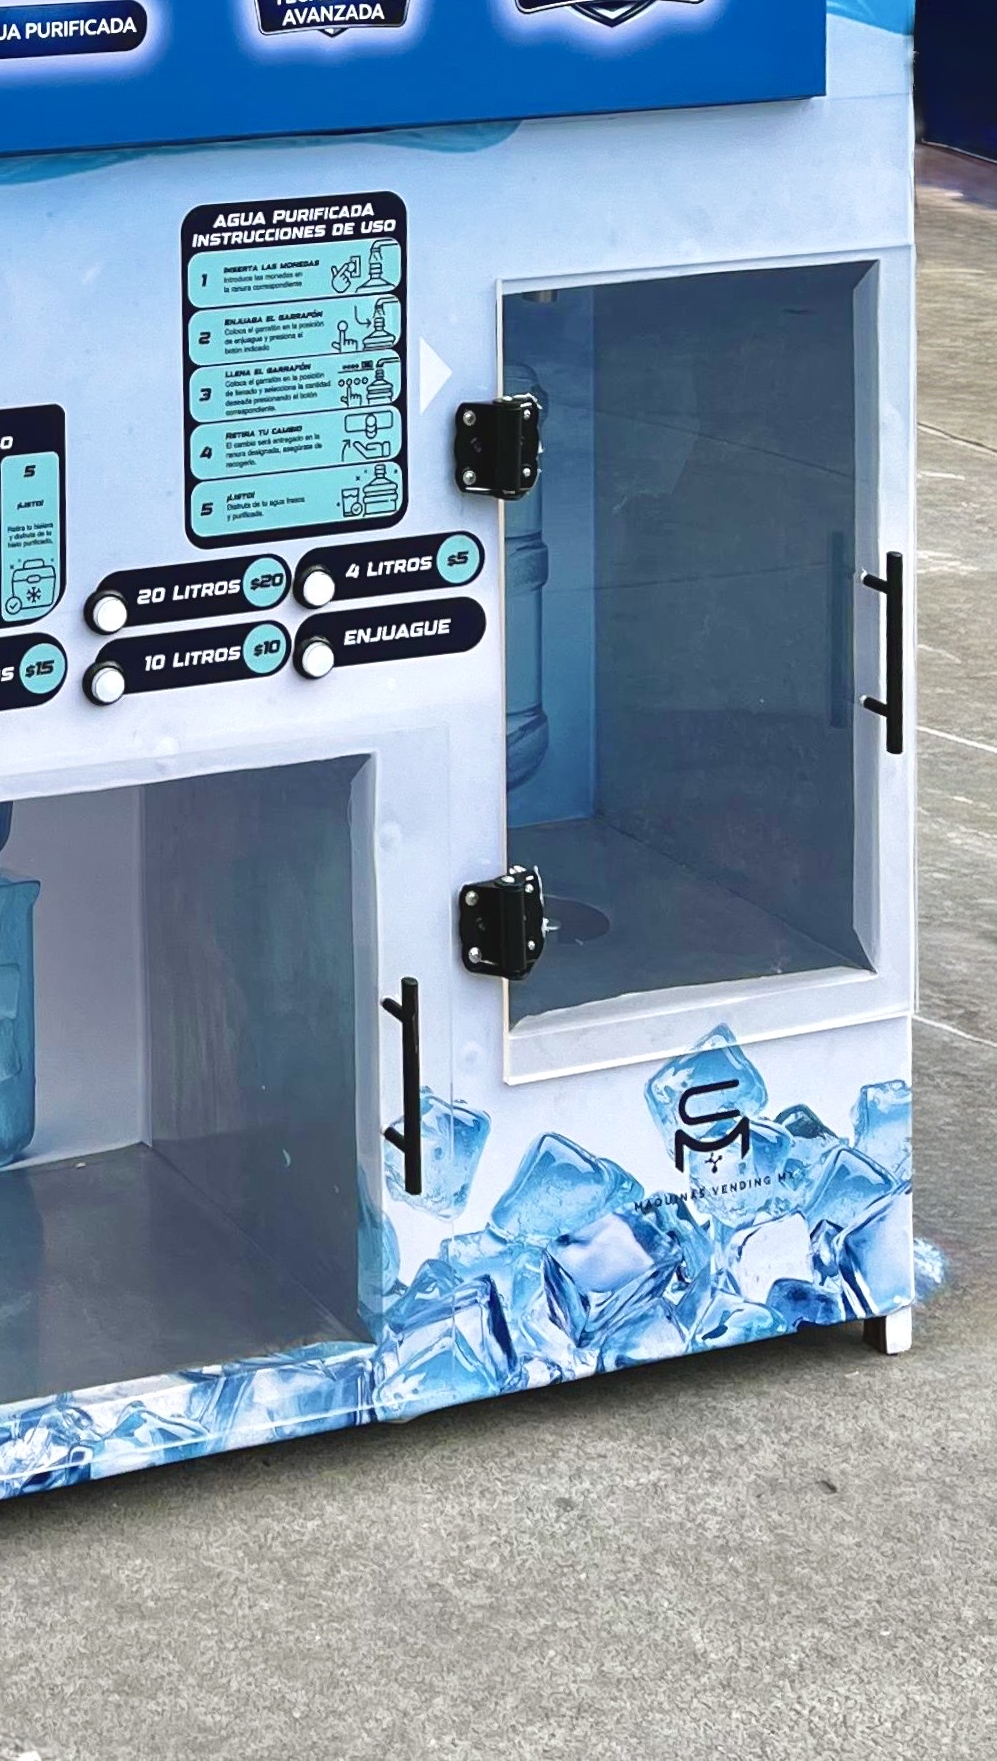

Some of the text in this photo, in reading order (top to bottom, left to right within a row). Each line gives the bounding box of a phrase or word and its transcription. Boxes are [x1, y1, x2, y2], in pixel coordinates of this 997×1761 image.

[281, 3, 386, 27] AVANZADA
[25, 17, 138, 39] PURIFICADA
[212, 202, 375, 228] AGUA PURIFICADA
[191, 219, 397, 248] INSTRUCCIONES DE USO
[202, 274, 208, 287] 1
[198, 331, 211, 345] 2
[198, 388, 212, 402] 3
[200, 446, 212, 459] 4
[23, 464, 36, 478] 5
[200, 502, 214, 516] 5
[345, 555, 434, 580] 4 LITROS
[446, 551, 470, 568] $5
[250, 572, 284, 591] $20
[136, 578, 242, 606] 20 LITROS
[342, 618, 452, 646] ENJUAGUE
[144, 646, 242, 672] 10 LITROS
[252, 640, 281, 658] $10
[24, 659, 56, 679] $15
[634, 1185, 705, 1212] MAQUINAS
[712, 1175, 772, 1196] VENDING
